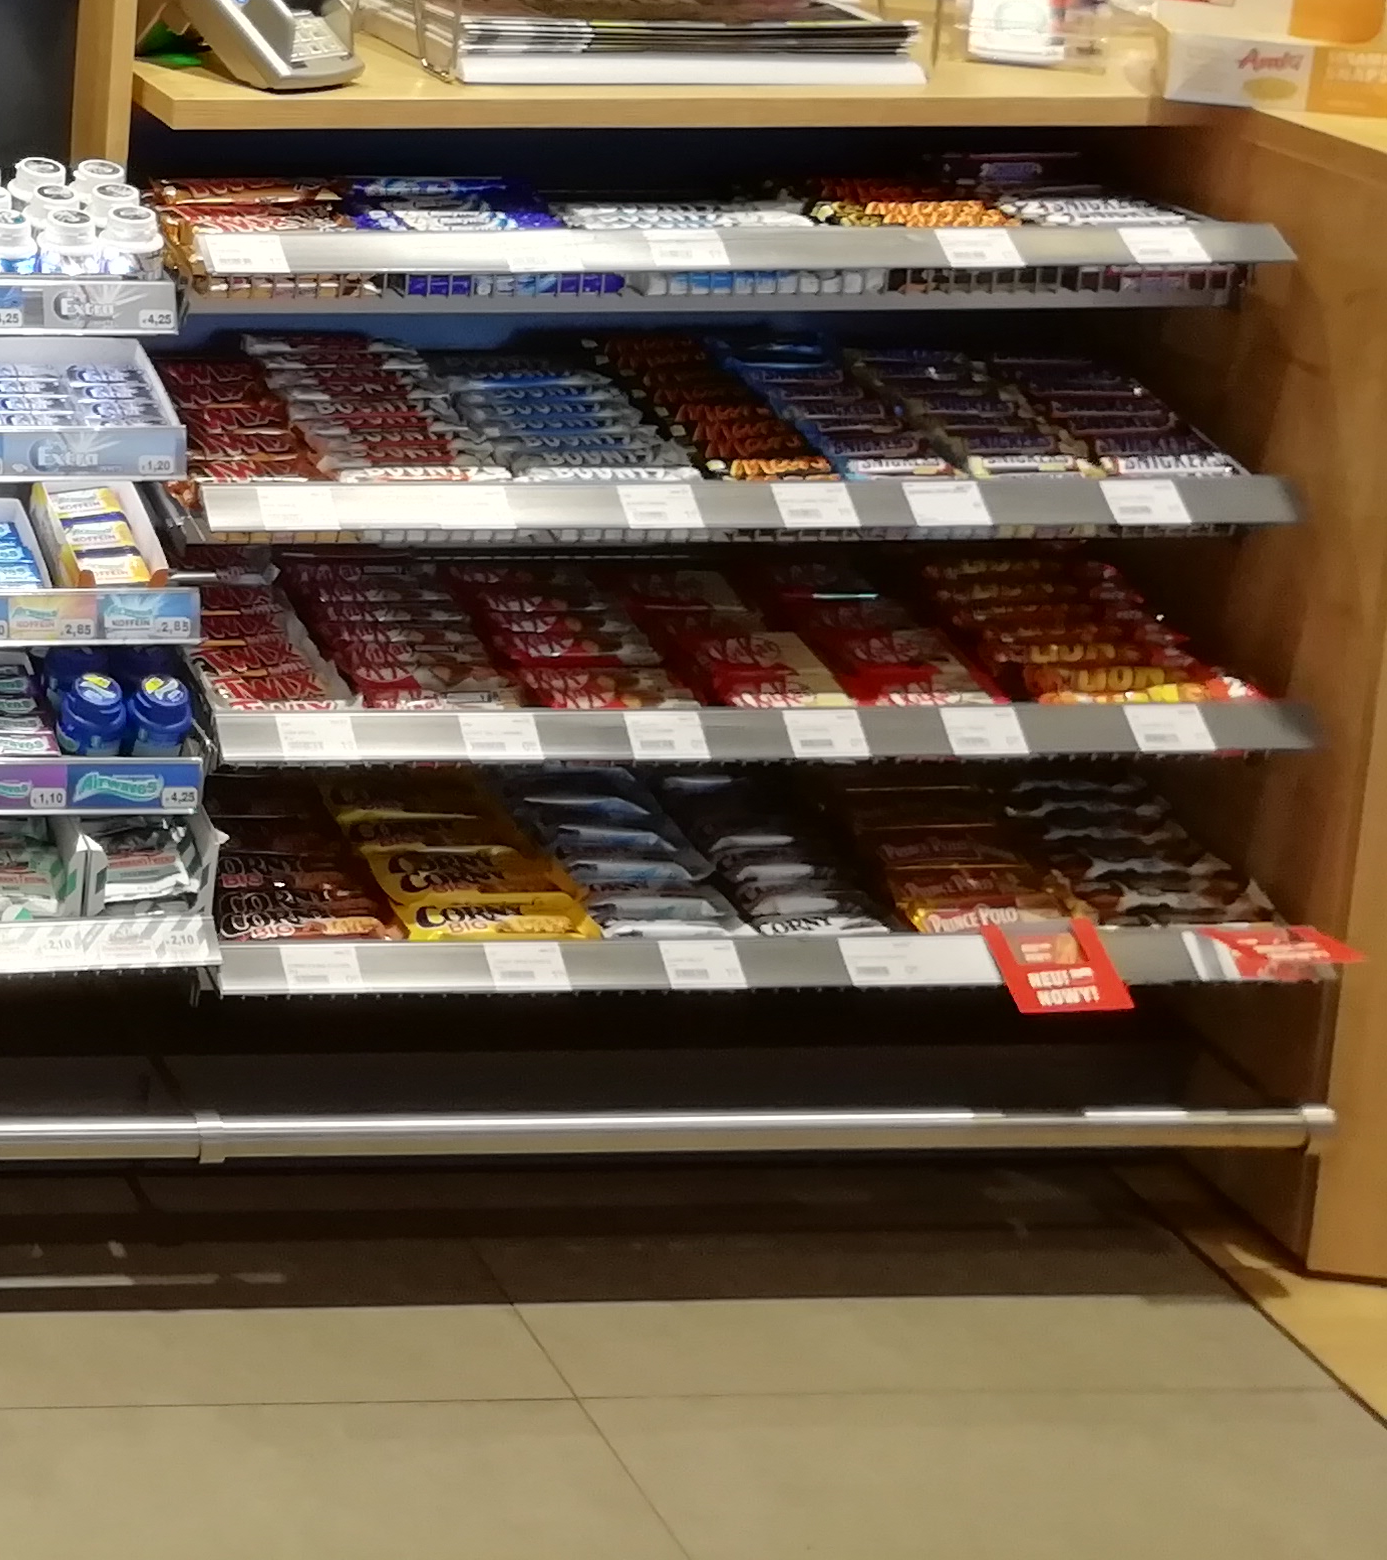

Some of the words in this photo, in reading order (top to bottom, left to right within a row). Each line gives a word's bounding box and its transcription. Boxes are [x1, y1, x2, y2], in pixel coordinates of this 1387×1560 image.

[77, 773, 160, 801] Airwaves
[449, 920, 488, 933] BIG
[928, 911, 977, 932] PRINCE
[982, 907, 1018, 924] POLO
